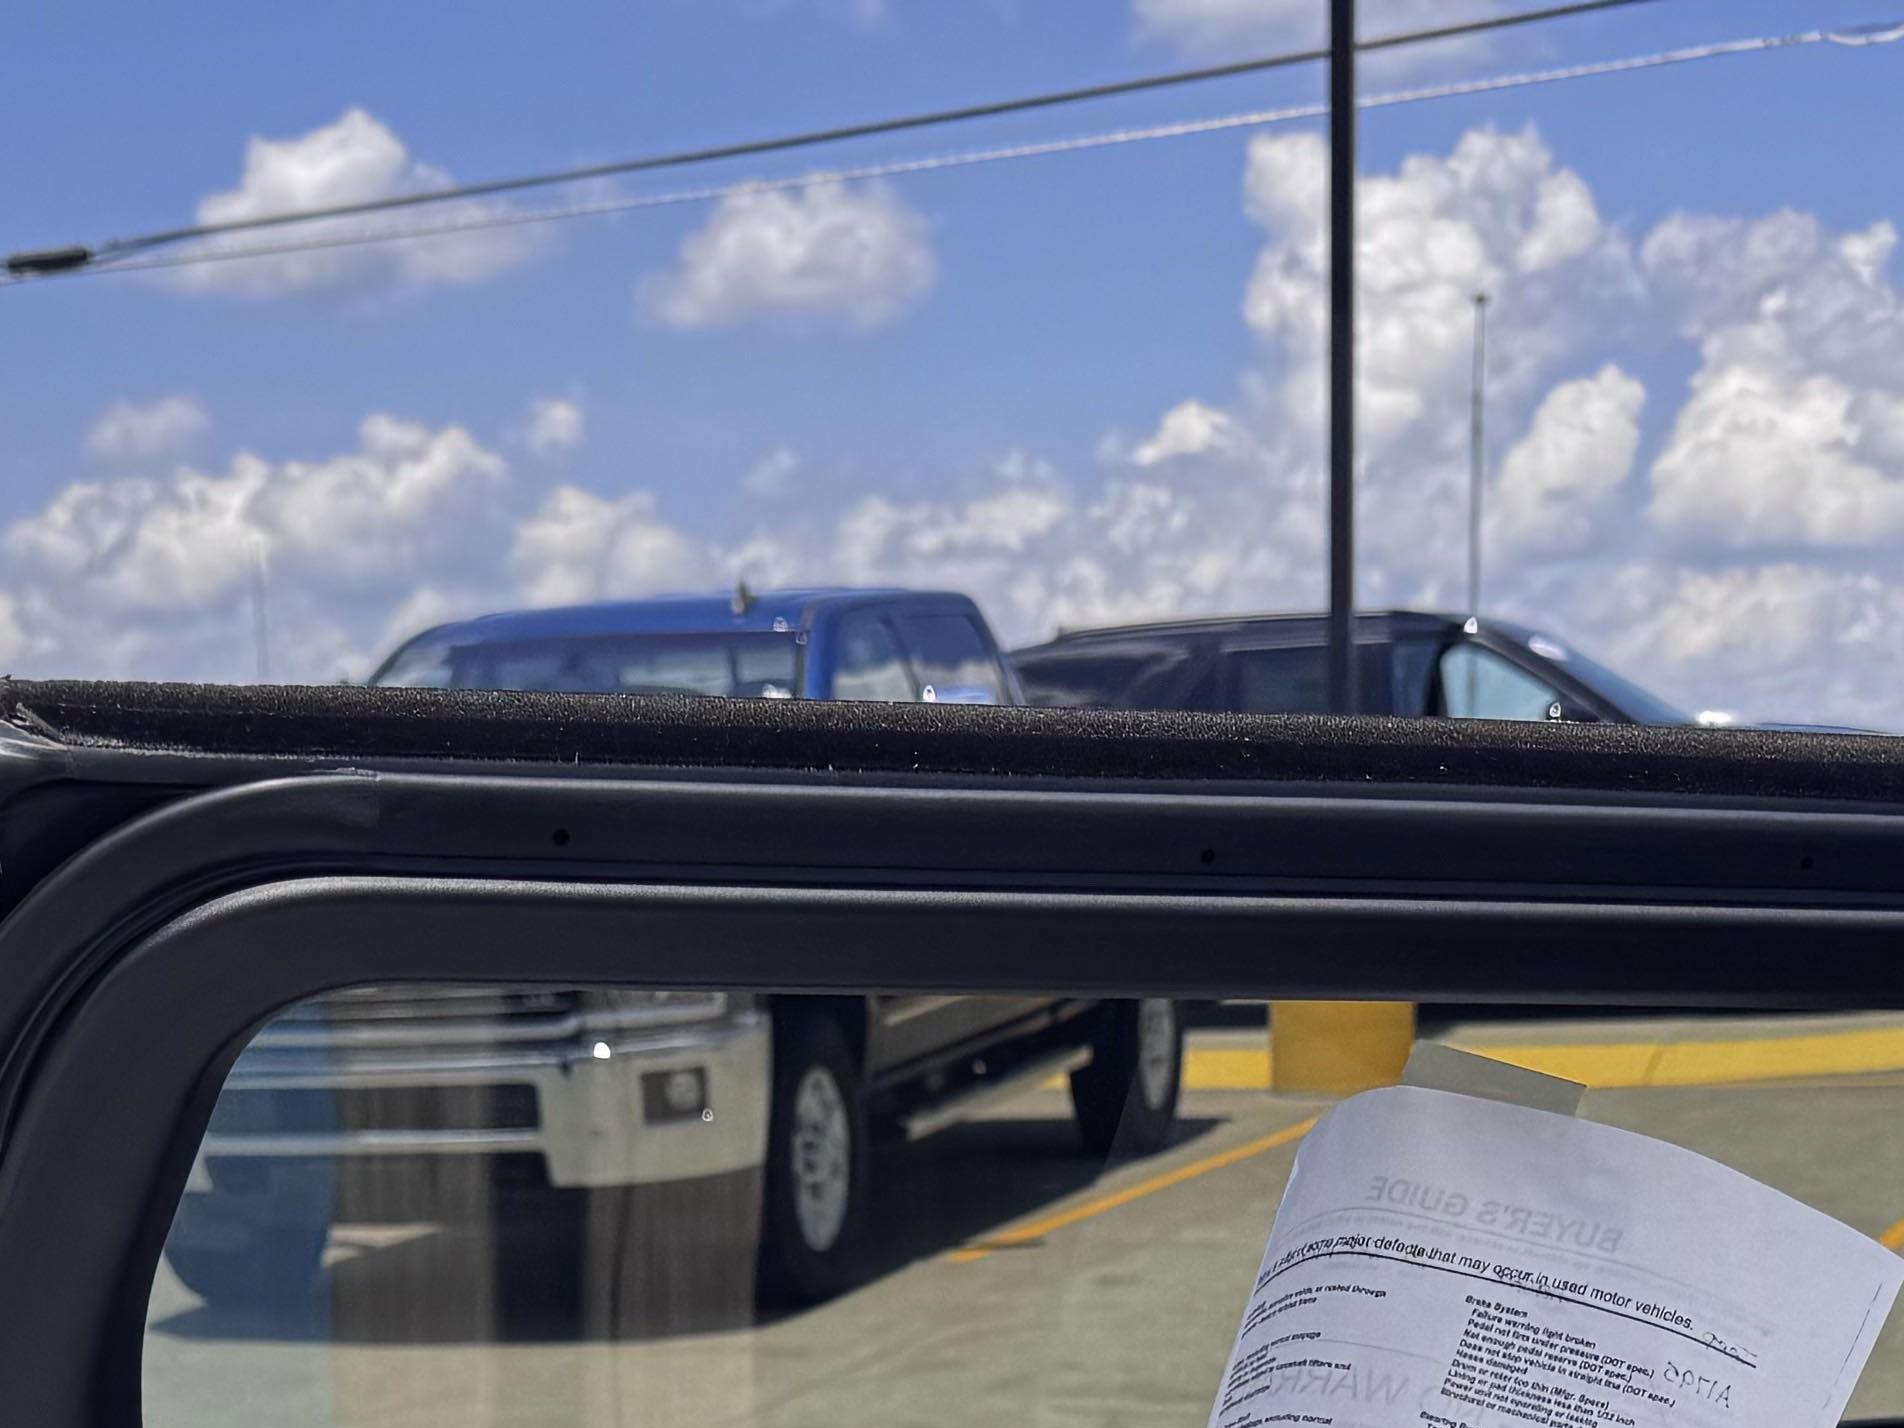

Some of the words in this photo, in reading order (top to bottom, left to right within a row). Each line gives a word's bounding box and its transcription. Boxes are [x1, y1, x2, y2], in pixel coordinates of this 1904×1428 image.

[1458, 1256, 1490, 1274] may
[1552, 1278, 1588, 1296] used
[1590, 1288, 1632, 1308] motor
[1636, 1301, 1693, 1330] vehicles.
[1564, 1333, 1596, 1350] broken
[1559, 1345, 1600, 1362] pressure
[1599, 1355, 1625, 1369] (DOT
[1578, 1360, 1603, 1374] (DOT
[1622, 1384, 1646, 1397] (DOT
